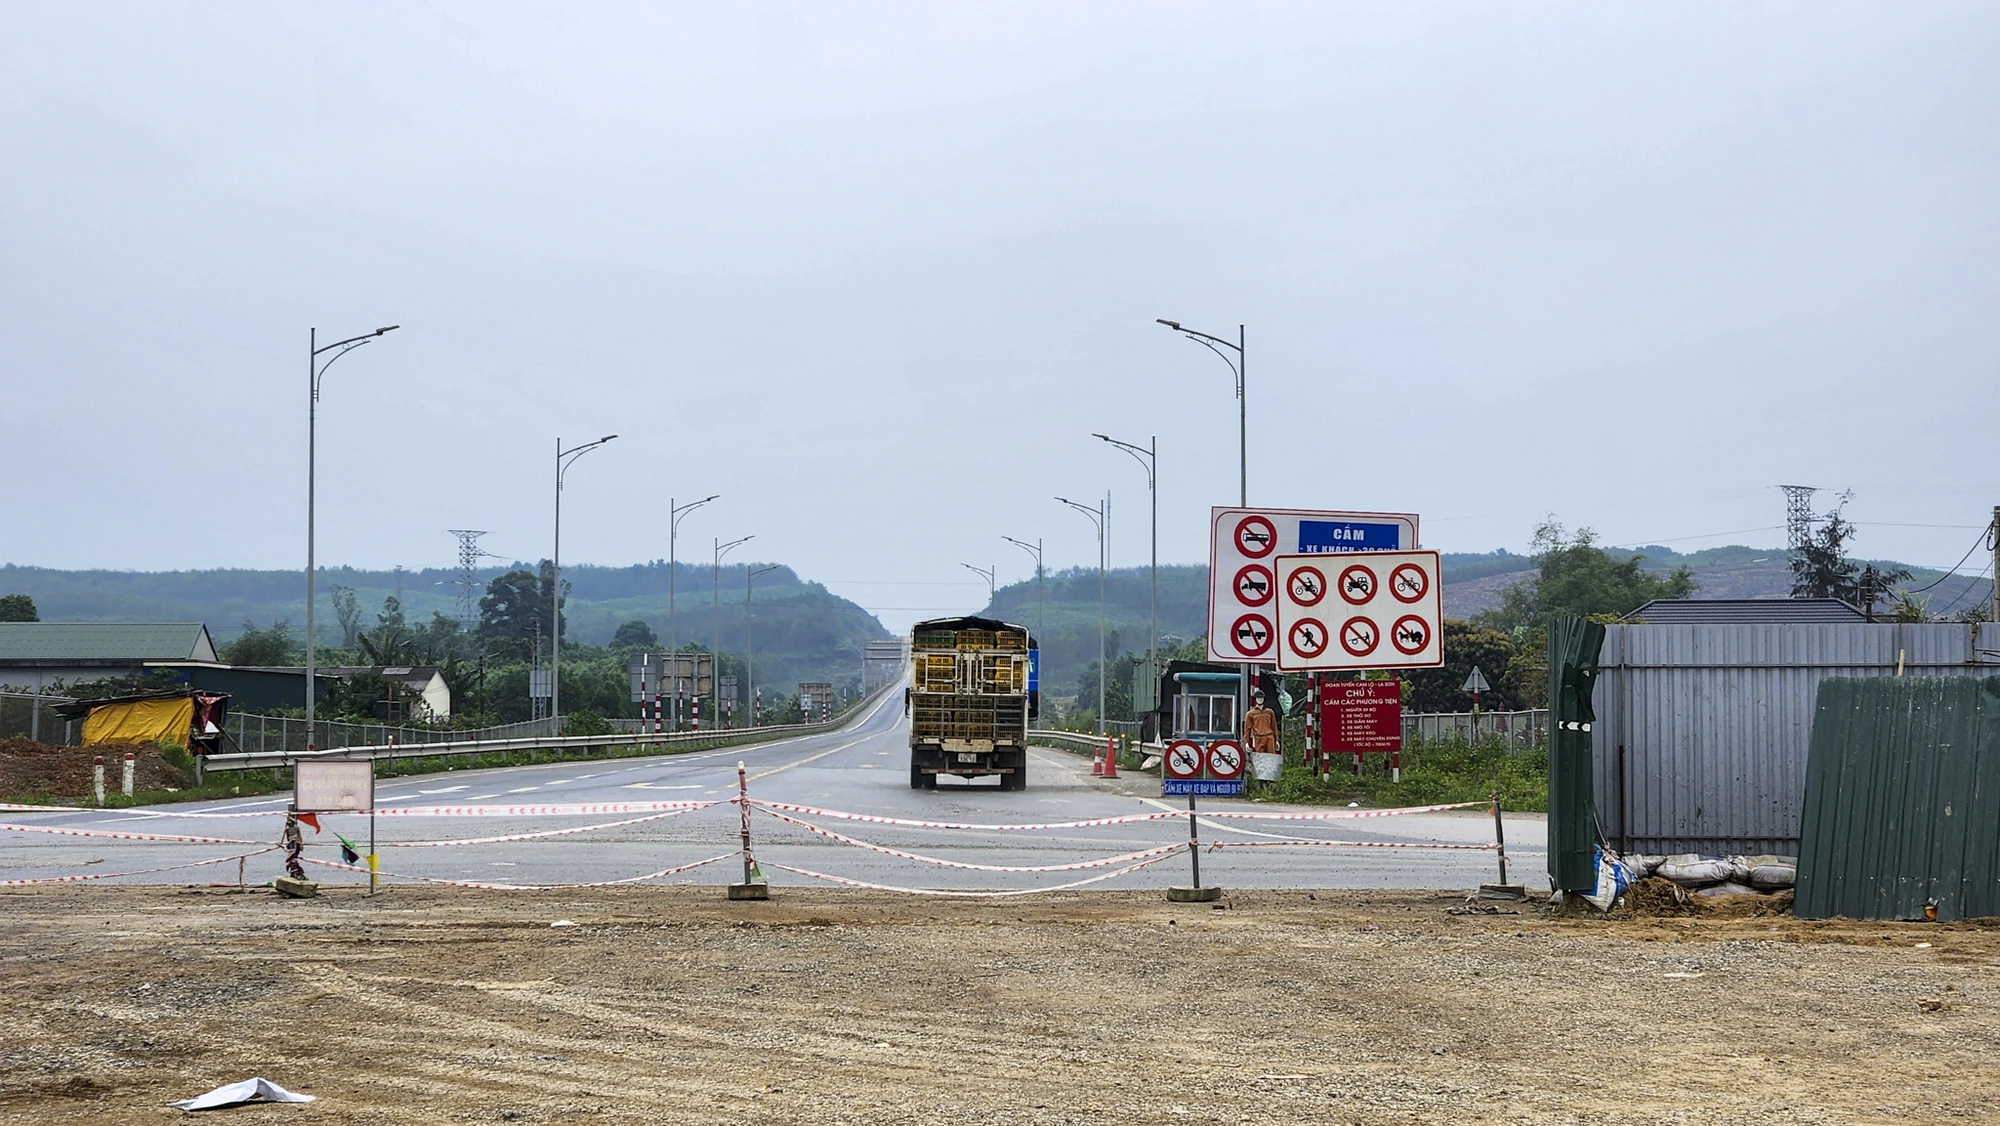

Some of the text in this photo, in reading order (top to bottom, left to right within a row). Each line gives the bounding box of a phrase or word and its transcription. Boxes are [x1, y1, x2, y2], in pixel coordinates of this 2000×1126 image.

[1333, 524, 1365, 541] CẤM
[1306, 544, 1318, 553] XE
[1346, 687, 1376, 697] CHÚ Ý:
[1194, 784, 1200, 794] XE
